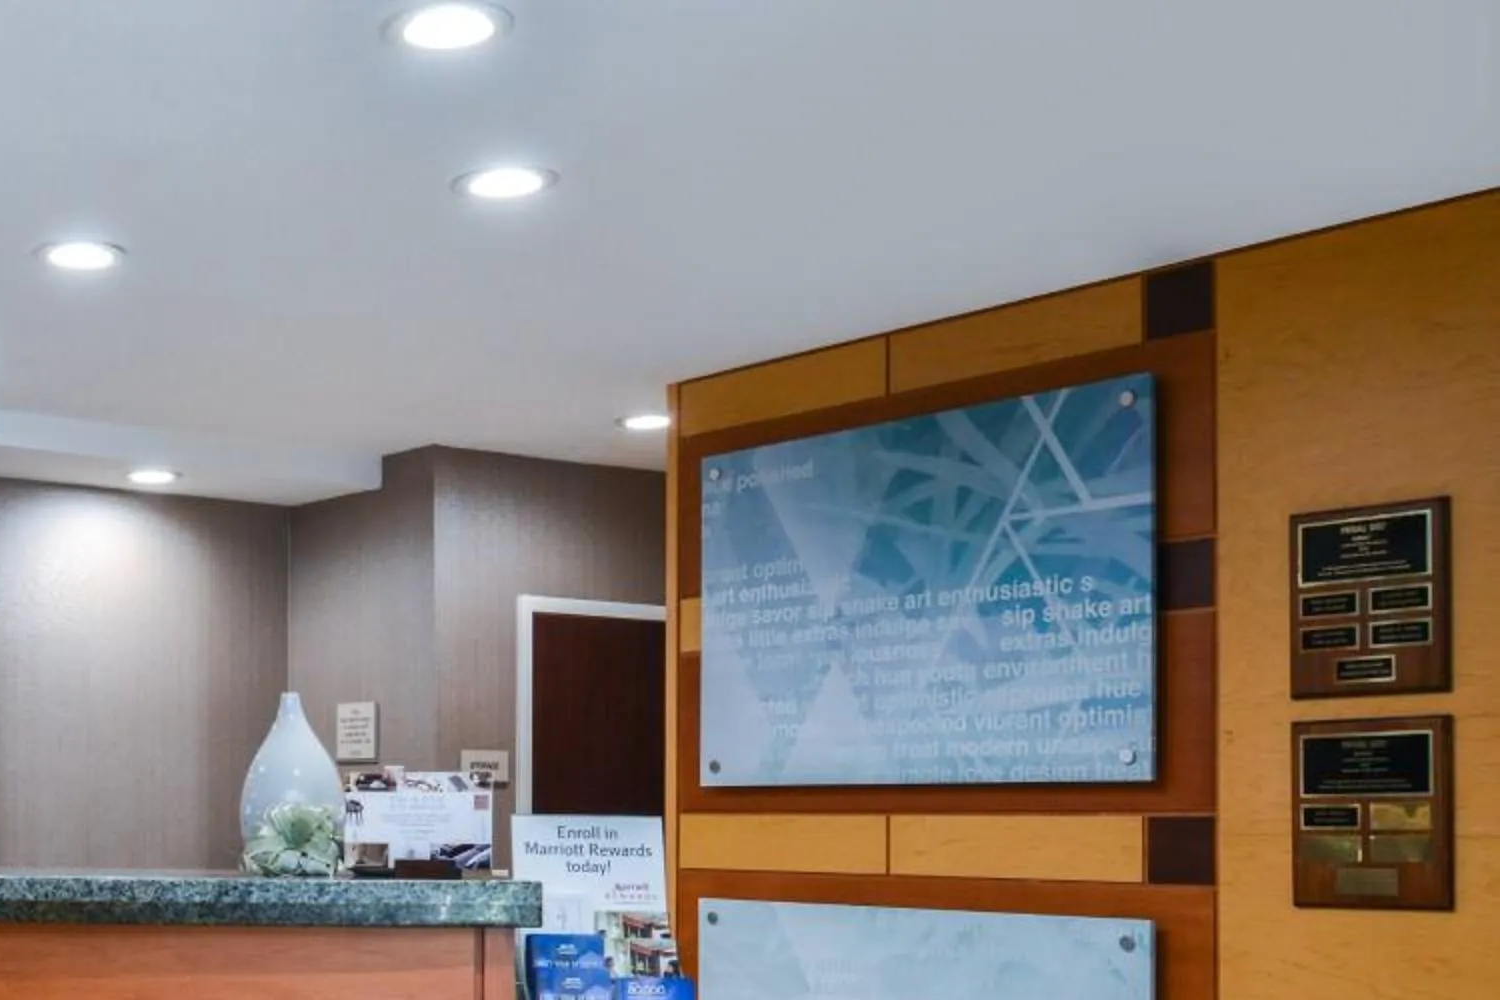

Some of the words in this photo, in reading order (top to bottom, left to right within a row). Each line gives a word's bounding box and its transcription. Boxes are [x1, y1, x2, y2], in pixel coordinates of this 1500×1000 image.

[752, 606, 802, 625] savor
[904, 590, 931, 610] art
[939, 573, 1074, 608] enthusiastic
[1080, 574, 1094, 593] s
[1001, 604, 1035, 631] sip
[1041, 597, 1113, 623] shake
[1119, 592, 1153, 616] art
[999, 631, 1073, 653] extras
[1096, 679, 1142, 699] hue
[973, 708, 1053, 732] vibrant
[557, 825, 601, 841] Enroll
[604, 826, 619, 840] in
[524, 841, 586, 858] Marriott
[589, 842, 653, 858] Rewards
[566, 859, 612, 876] today!
